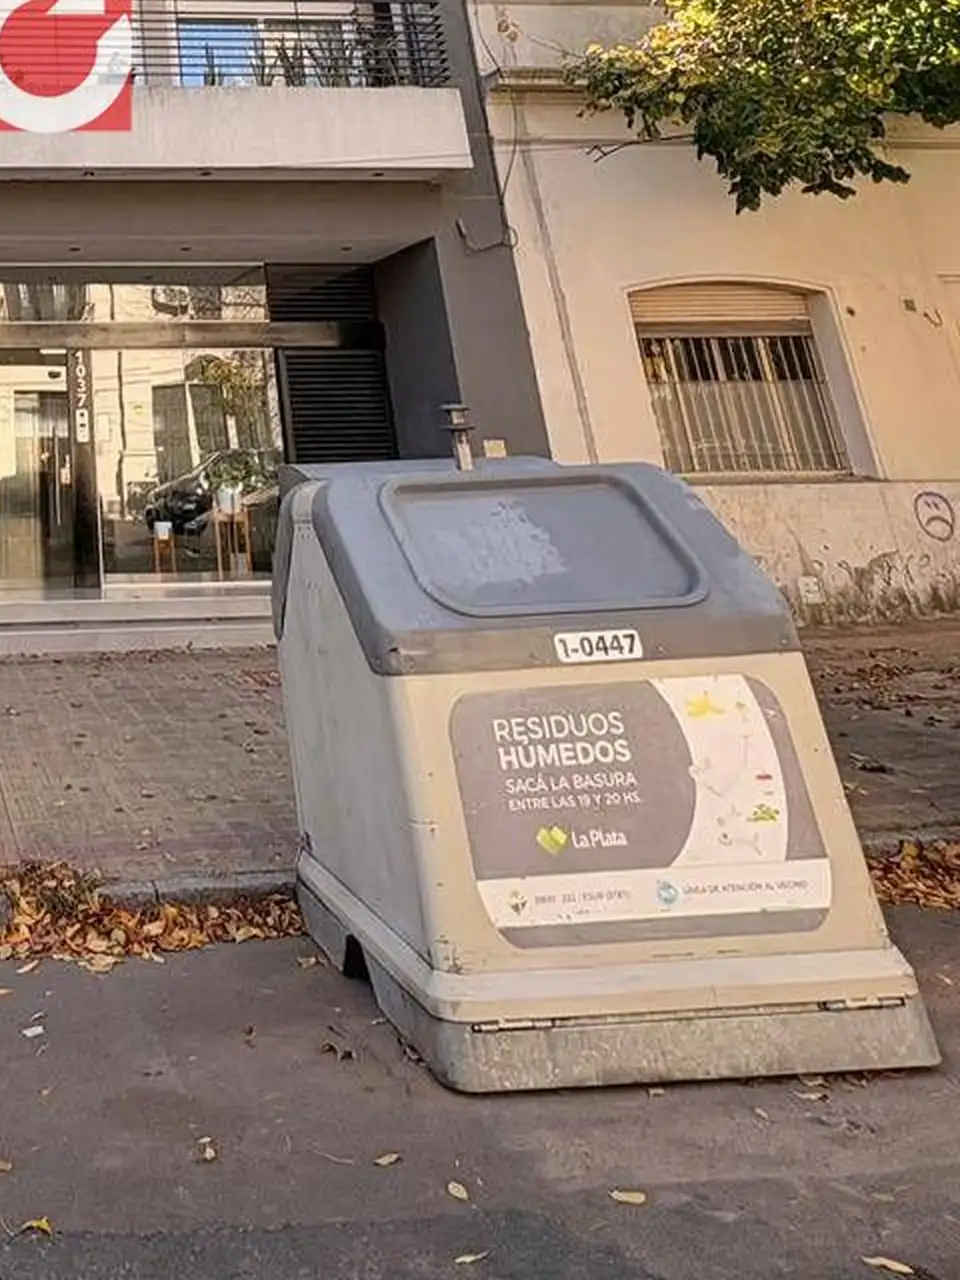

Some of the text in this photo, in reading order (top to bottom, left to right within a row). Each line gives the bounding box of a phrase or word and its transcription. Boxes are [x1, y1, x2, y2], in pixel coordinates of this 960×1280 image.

[74, 350, 88, 408] 1037
[558, 633, 636, 658] 1-0447
[493, 711, 625, 742] RESIDUOS
[549, 776, 571, 791] LA
[572, 771, 638, 789] BASURA
[508, 797, 550, 812] ENTRE
[551, 795, 576, 809] LAS
[604, 792, 621, 805] 20
[571, 825, 628, 849] La Plata
